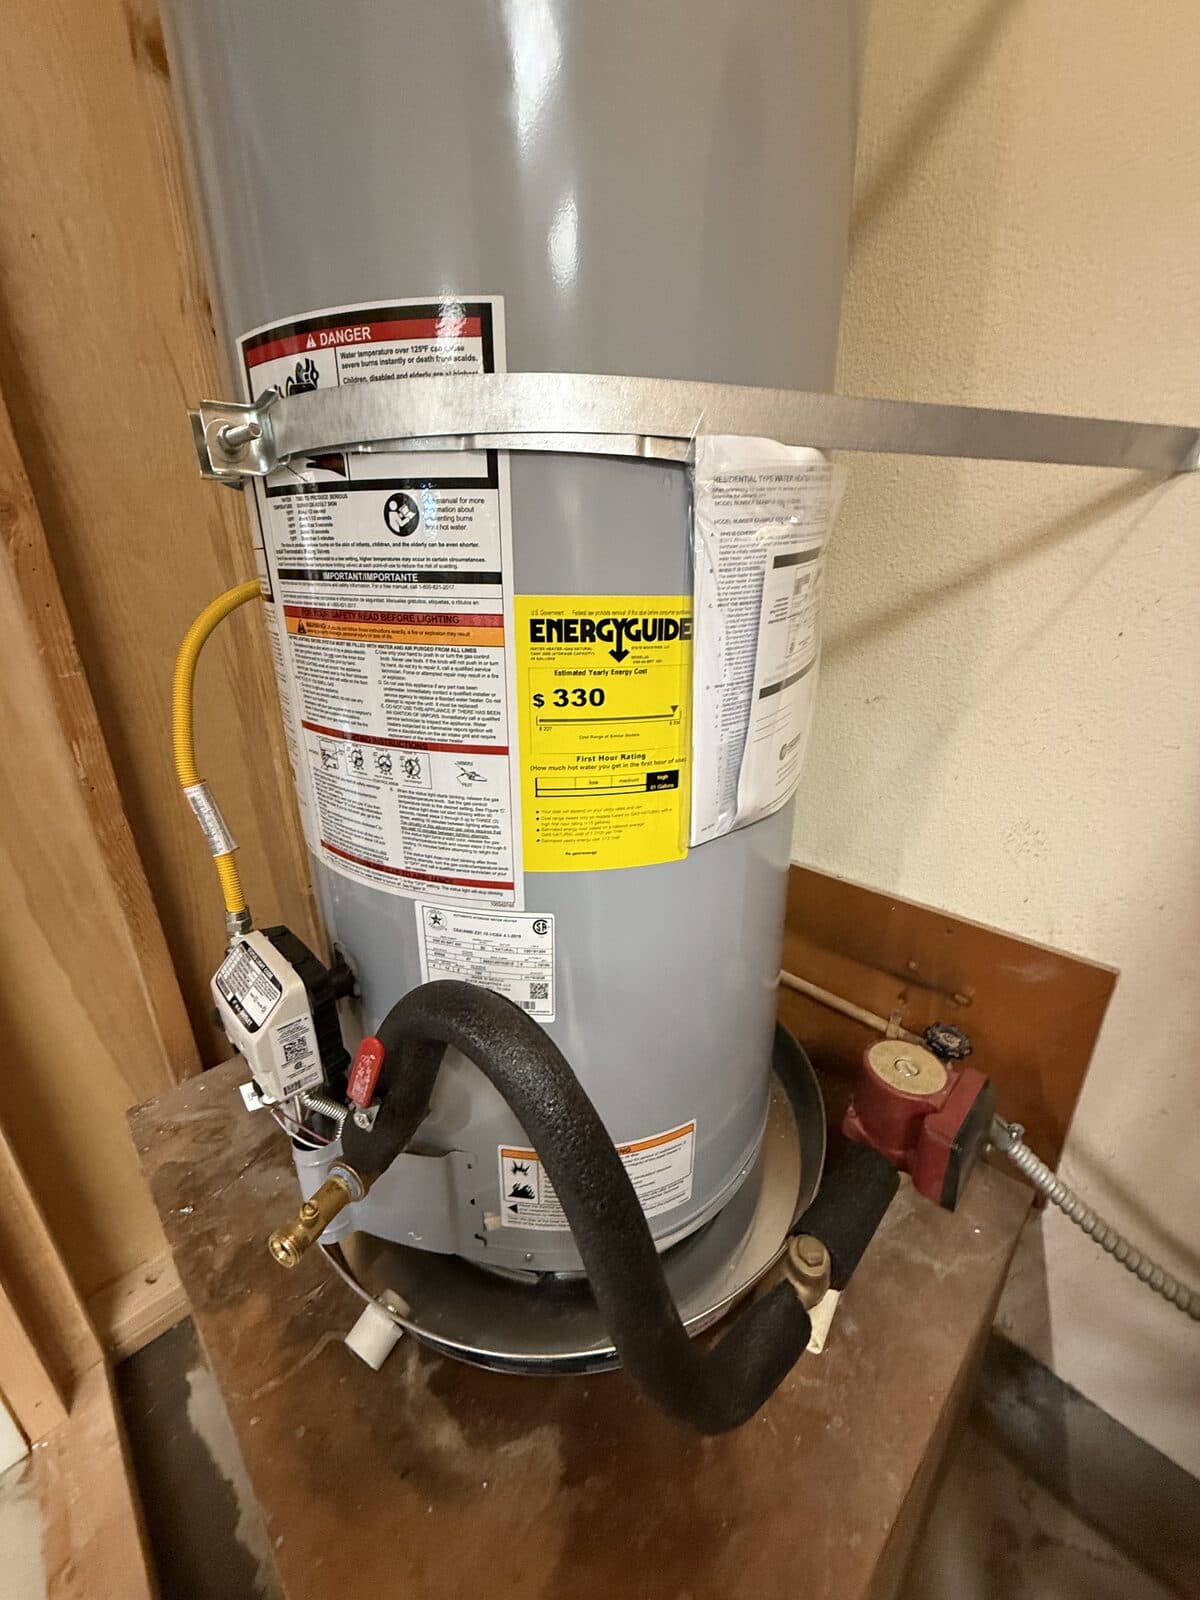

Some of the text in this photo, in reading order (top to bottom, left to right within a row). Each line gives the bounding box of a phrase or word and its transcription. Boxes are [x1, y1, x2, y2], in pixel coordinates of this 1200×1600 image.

[320, 327, 372, 346] DANGER
[340, 352, 356, 360] Water
[358, 349, 394, 358] temperature
[361, 360, 378, 368] burns
[380, 358, 406, 366] instantly
[416, 354, 434, 363] death
[370, 373, 395, 382] disabled
[381, 614, 414, 622] BEFORE
[416, 616, 460, 624] LIGHTING
[530, 618, 692, 643] ENERGYGUIDE
[589, 669, 608, 677] Yearly
[533, 688, 605, 708] $ 330
